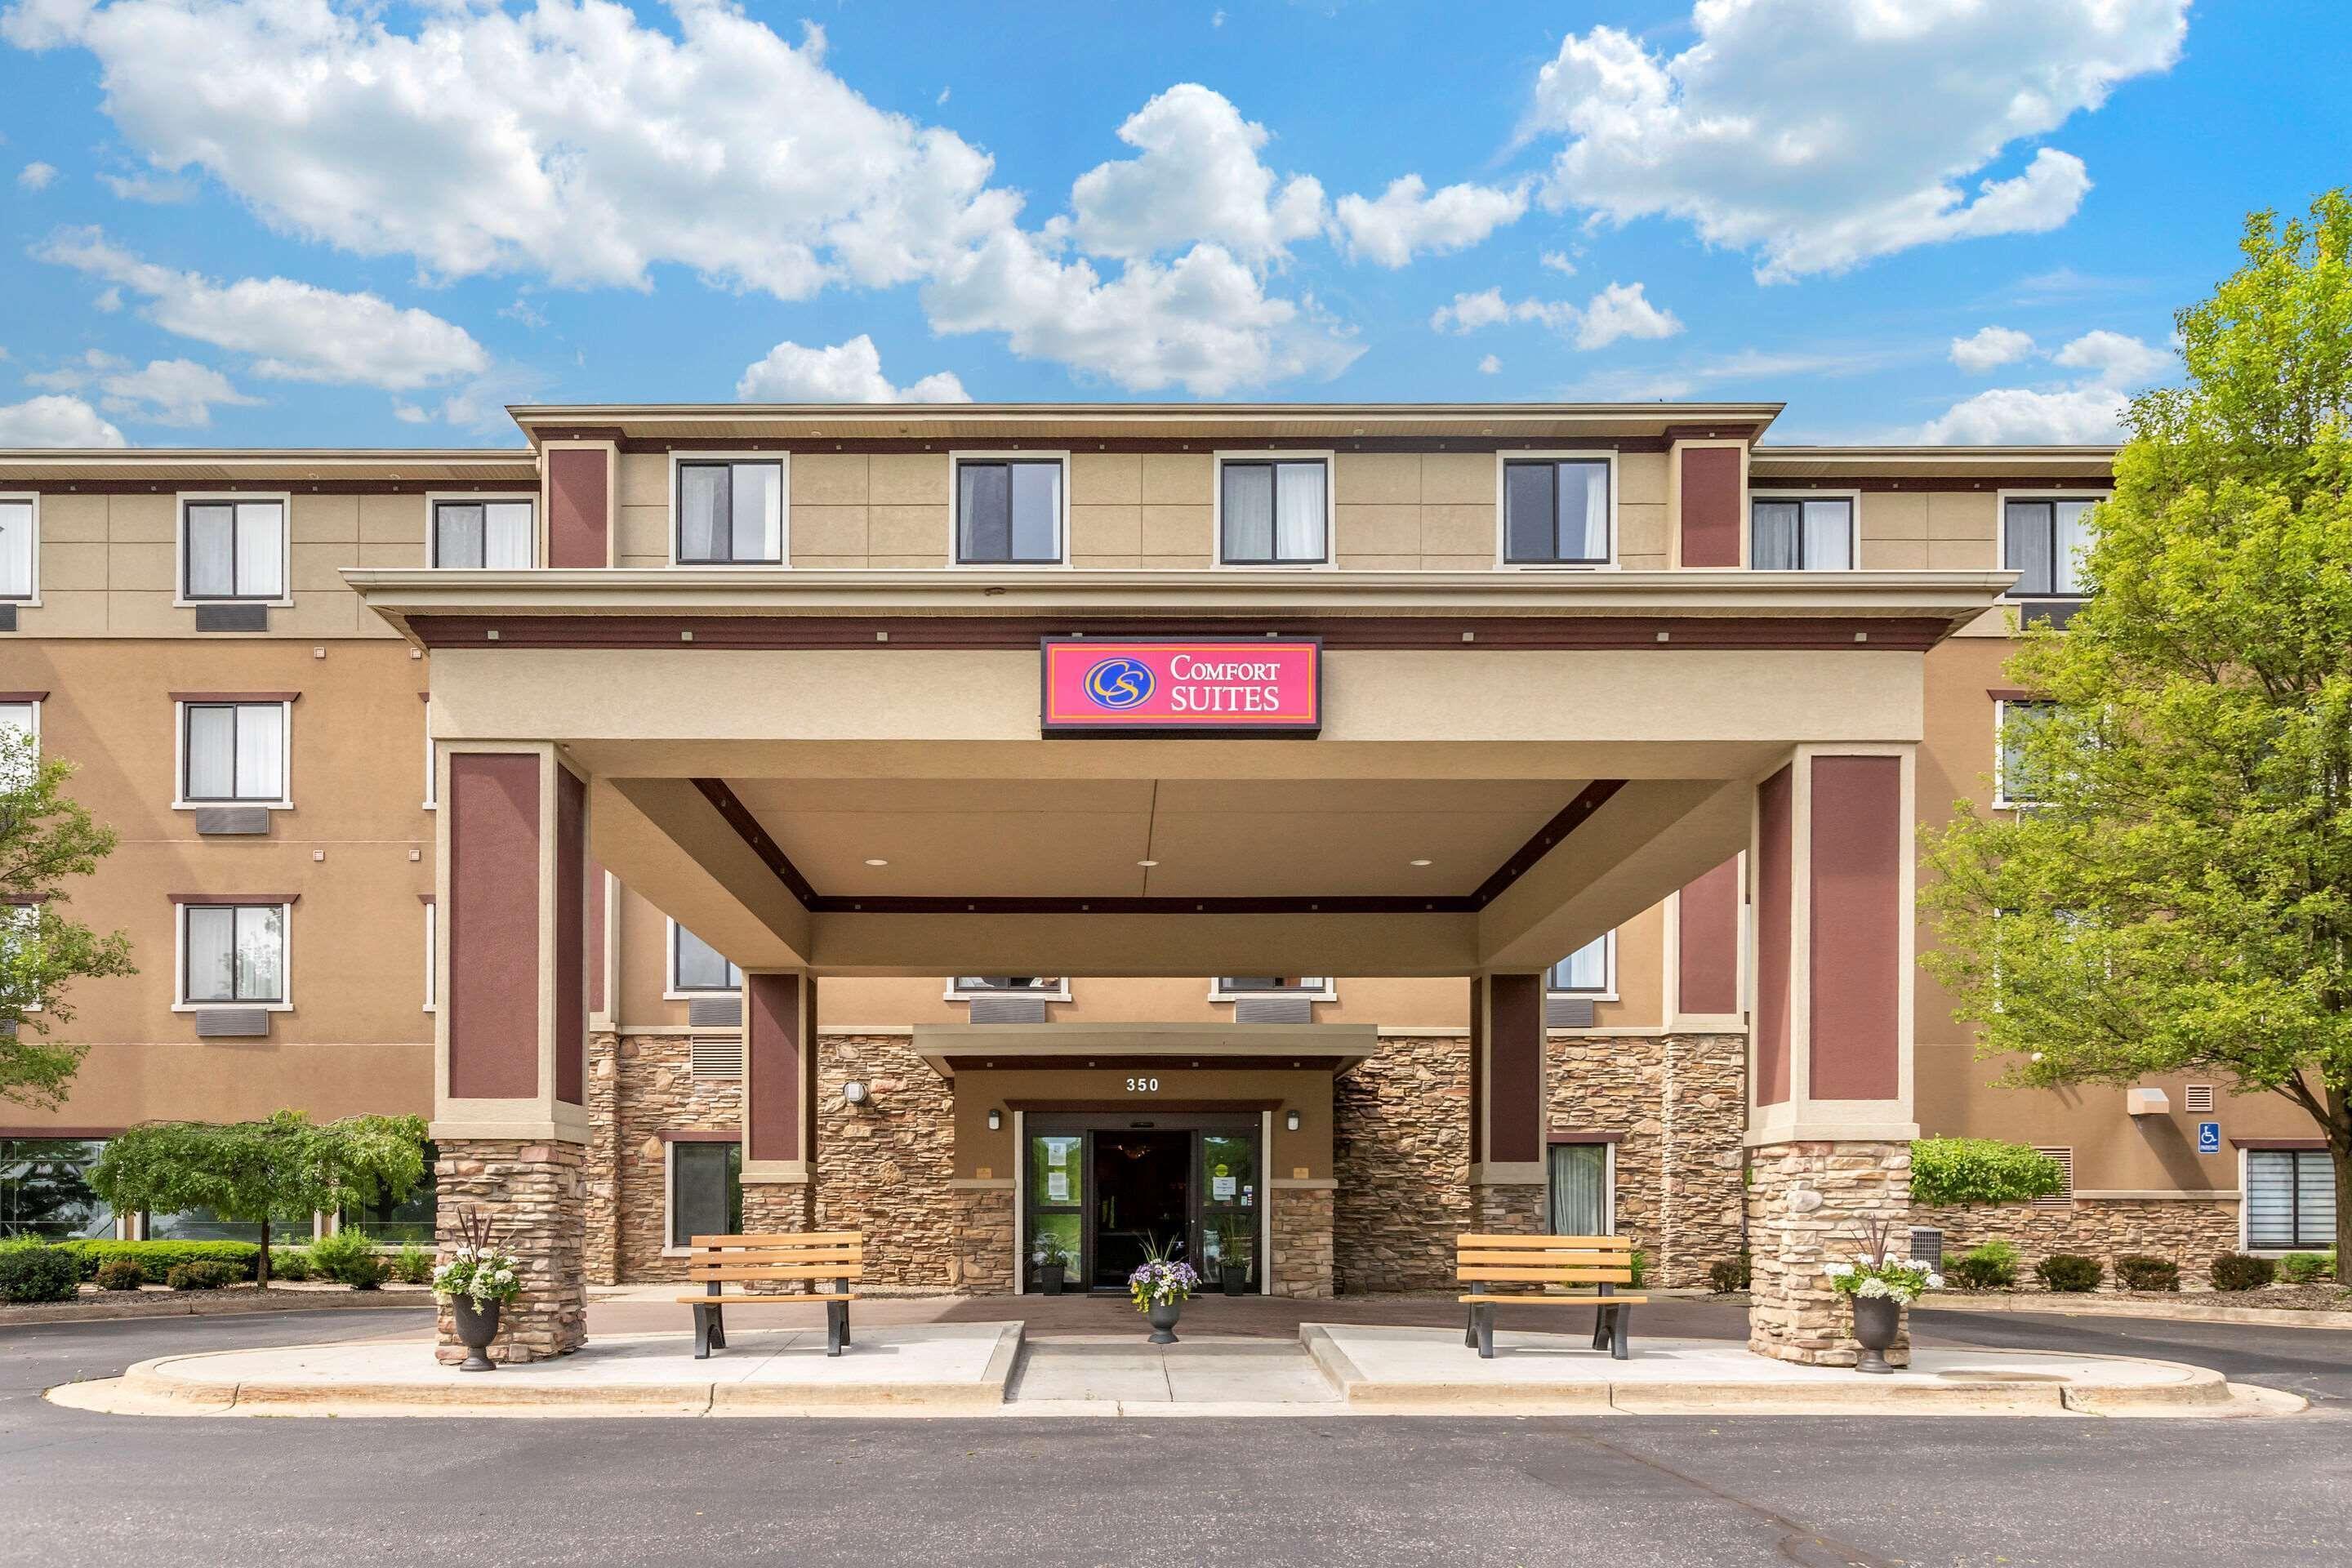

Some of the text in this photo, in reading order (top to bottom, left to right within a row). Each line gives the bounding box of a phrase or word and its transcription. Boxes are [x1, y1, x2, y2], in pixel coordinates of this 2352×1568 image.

[1169, 654, 1281, 681] COMFORT
[1170, 686, 1280, 711] SUITES
[1126, 1078, 1158, 1091] 350
